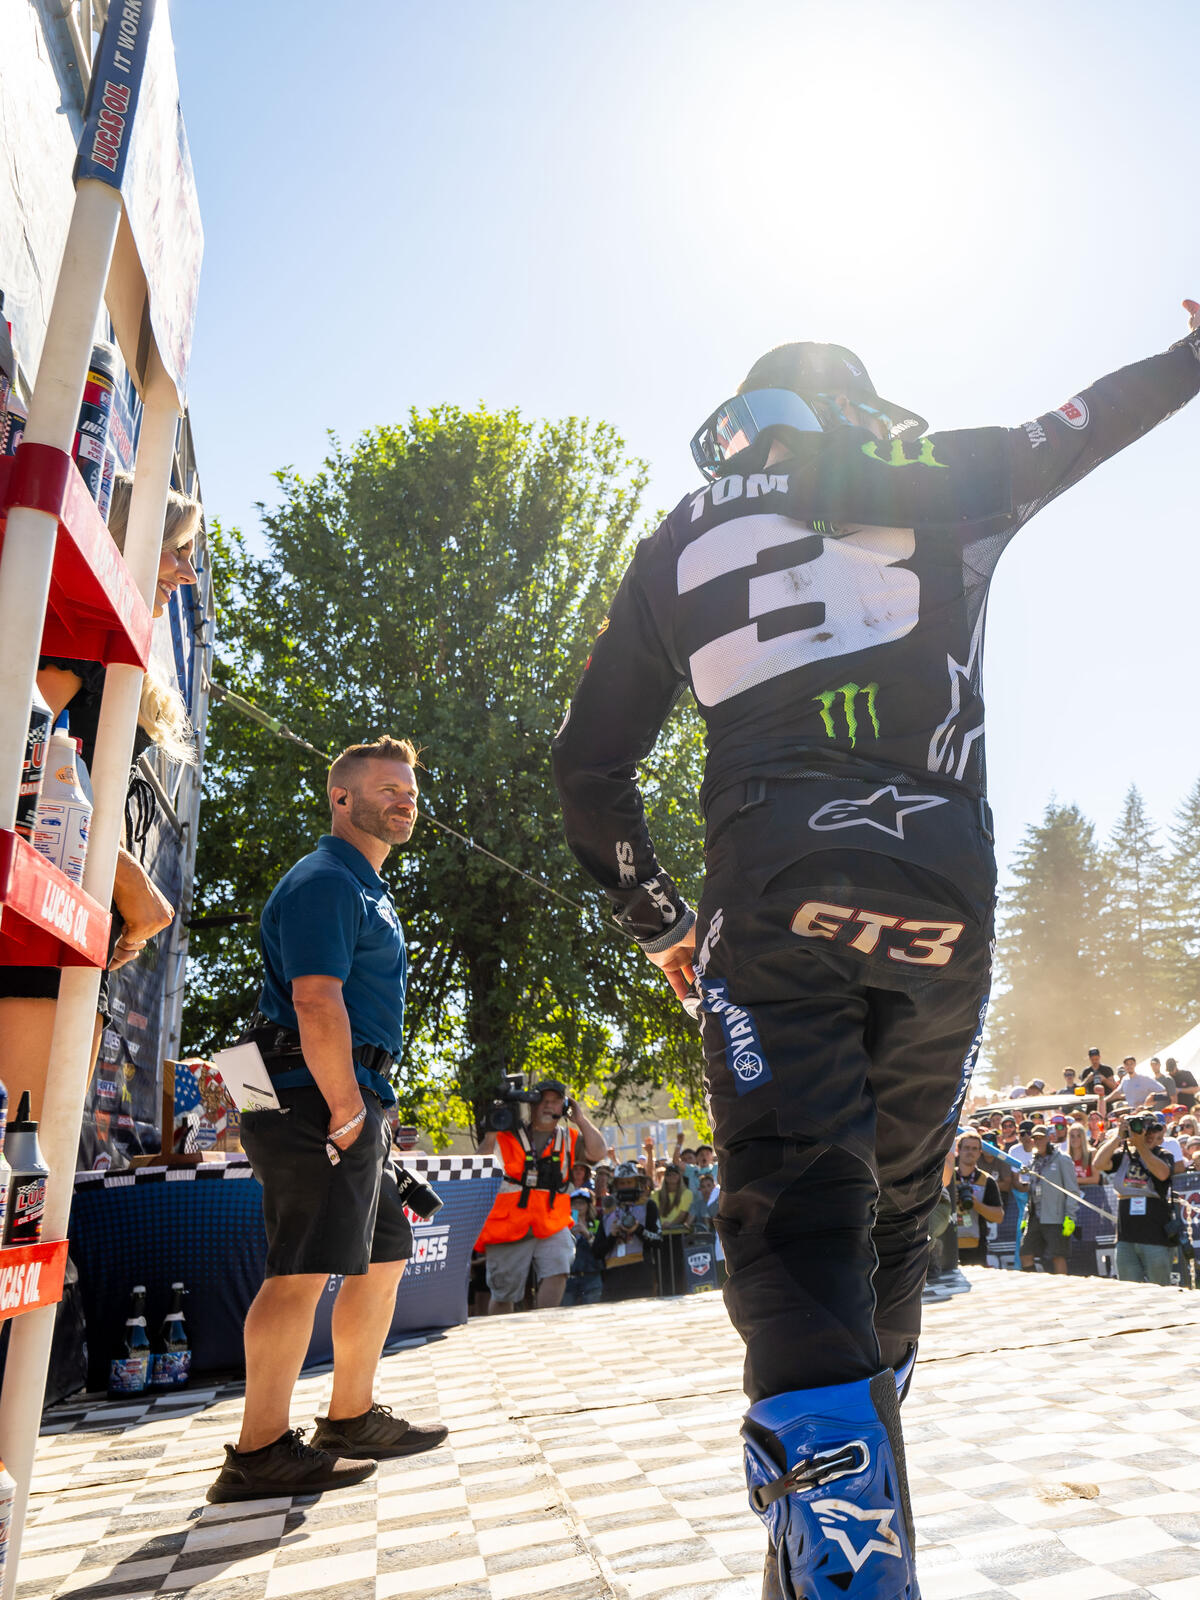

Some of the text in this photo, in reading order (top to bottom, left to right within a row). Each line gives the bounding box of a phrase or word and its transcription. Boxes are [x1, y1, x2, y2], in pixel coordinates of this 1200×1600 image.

[113, 50, 131, 73] IT
[102, 80, 131, 114] OIL
[91, 109, 126, 172] LUCAS
[677, 513, 920, 707] 3
[41, 880, 89, 949] LUCAS OIL
[25, 1262, 42, 1303] OIL
